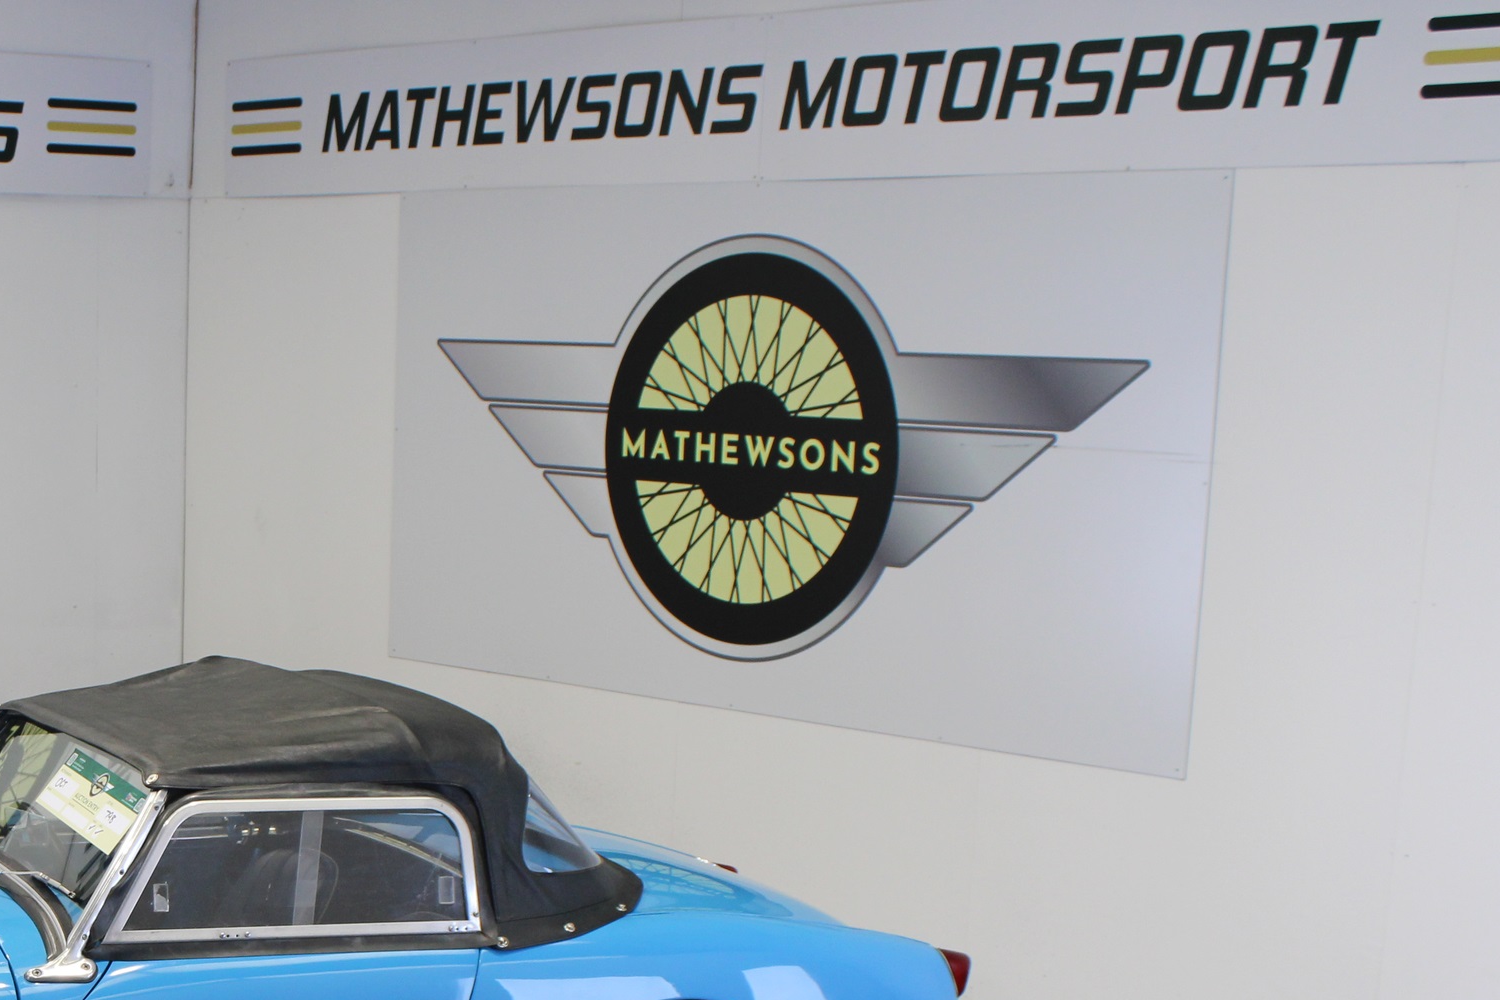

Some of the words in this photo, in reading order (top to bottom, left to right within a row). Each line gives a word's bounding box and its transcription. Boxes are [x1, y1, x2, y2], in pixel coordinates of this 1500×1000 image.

[321, 63, 764, 154] MATHEWSONS
[779, 19, 1382, 131] MOTORSPORT
[621, 426, 882, 476] MATHEWSONS
